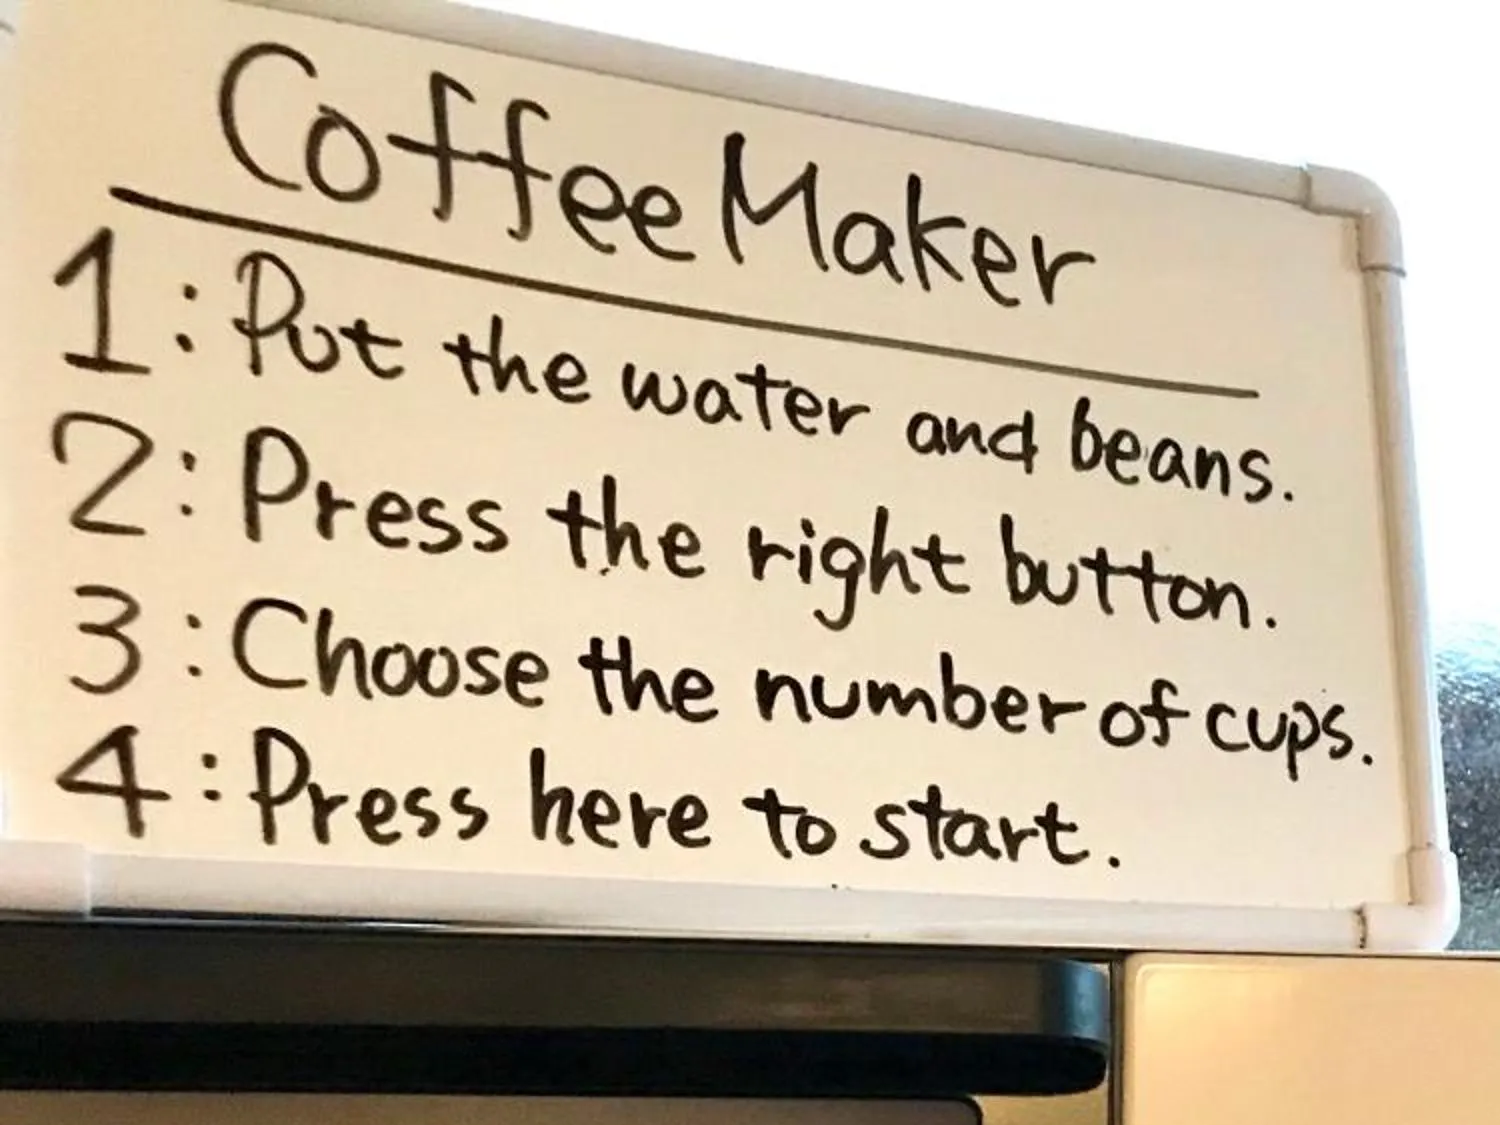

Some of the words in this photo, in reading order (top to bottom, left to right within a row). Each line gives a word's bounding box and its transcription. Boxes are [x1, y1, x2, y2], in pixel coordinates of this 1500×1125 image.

[217, 41, 698, 262] Coffee
[720, 131, 1098, 308] Maker
[52, 226, 198, 374] 1:
[231, 250, 405, 376] Put
[442, 313, 592, 404] the
[621, 362, 872, 436] water
[905, 408, 1042, 474] and
[1071, 396, 1296, 503] beans.
[51, 410, 197, 536] 2:
[242, 425, 510, 555] Press
[546, 474, 706, 578] the
[747, 505, 972, 632] right
[1000, 513, 1278, 630] button.
[68, 584, 203, 695] 3:
[231, 597, 550, 708] Choose
[578, 635, 720, 723] the
[754, 651, 1088, 735] number
[1099, 679, 1192, 748] of
[1205, 700, 1374, 782] cups.
[55, 724, 222, 838] 4:
[249, 726, 490, 846] Press
[529, 747, 712, 850] here
[742, 786, 838, 860] to
[858, 783, 1122, 870] start.
